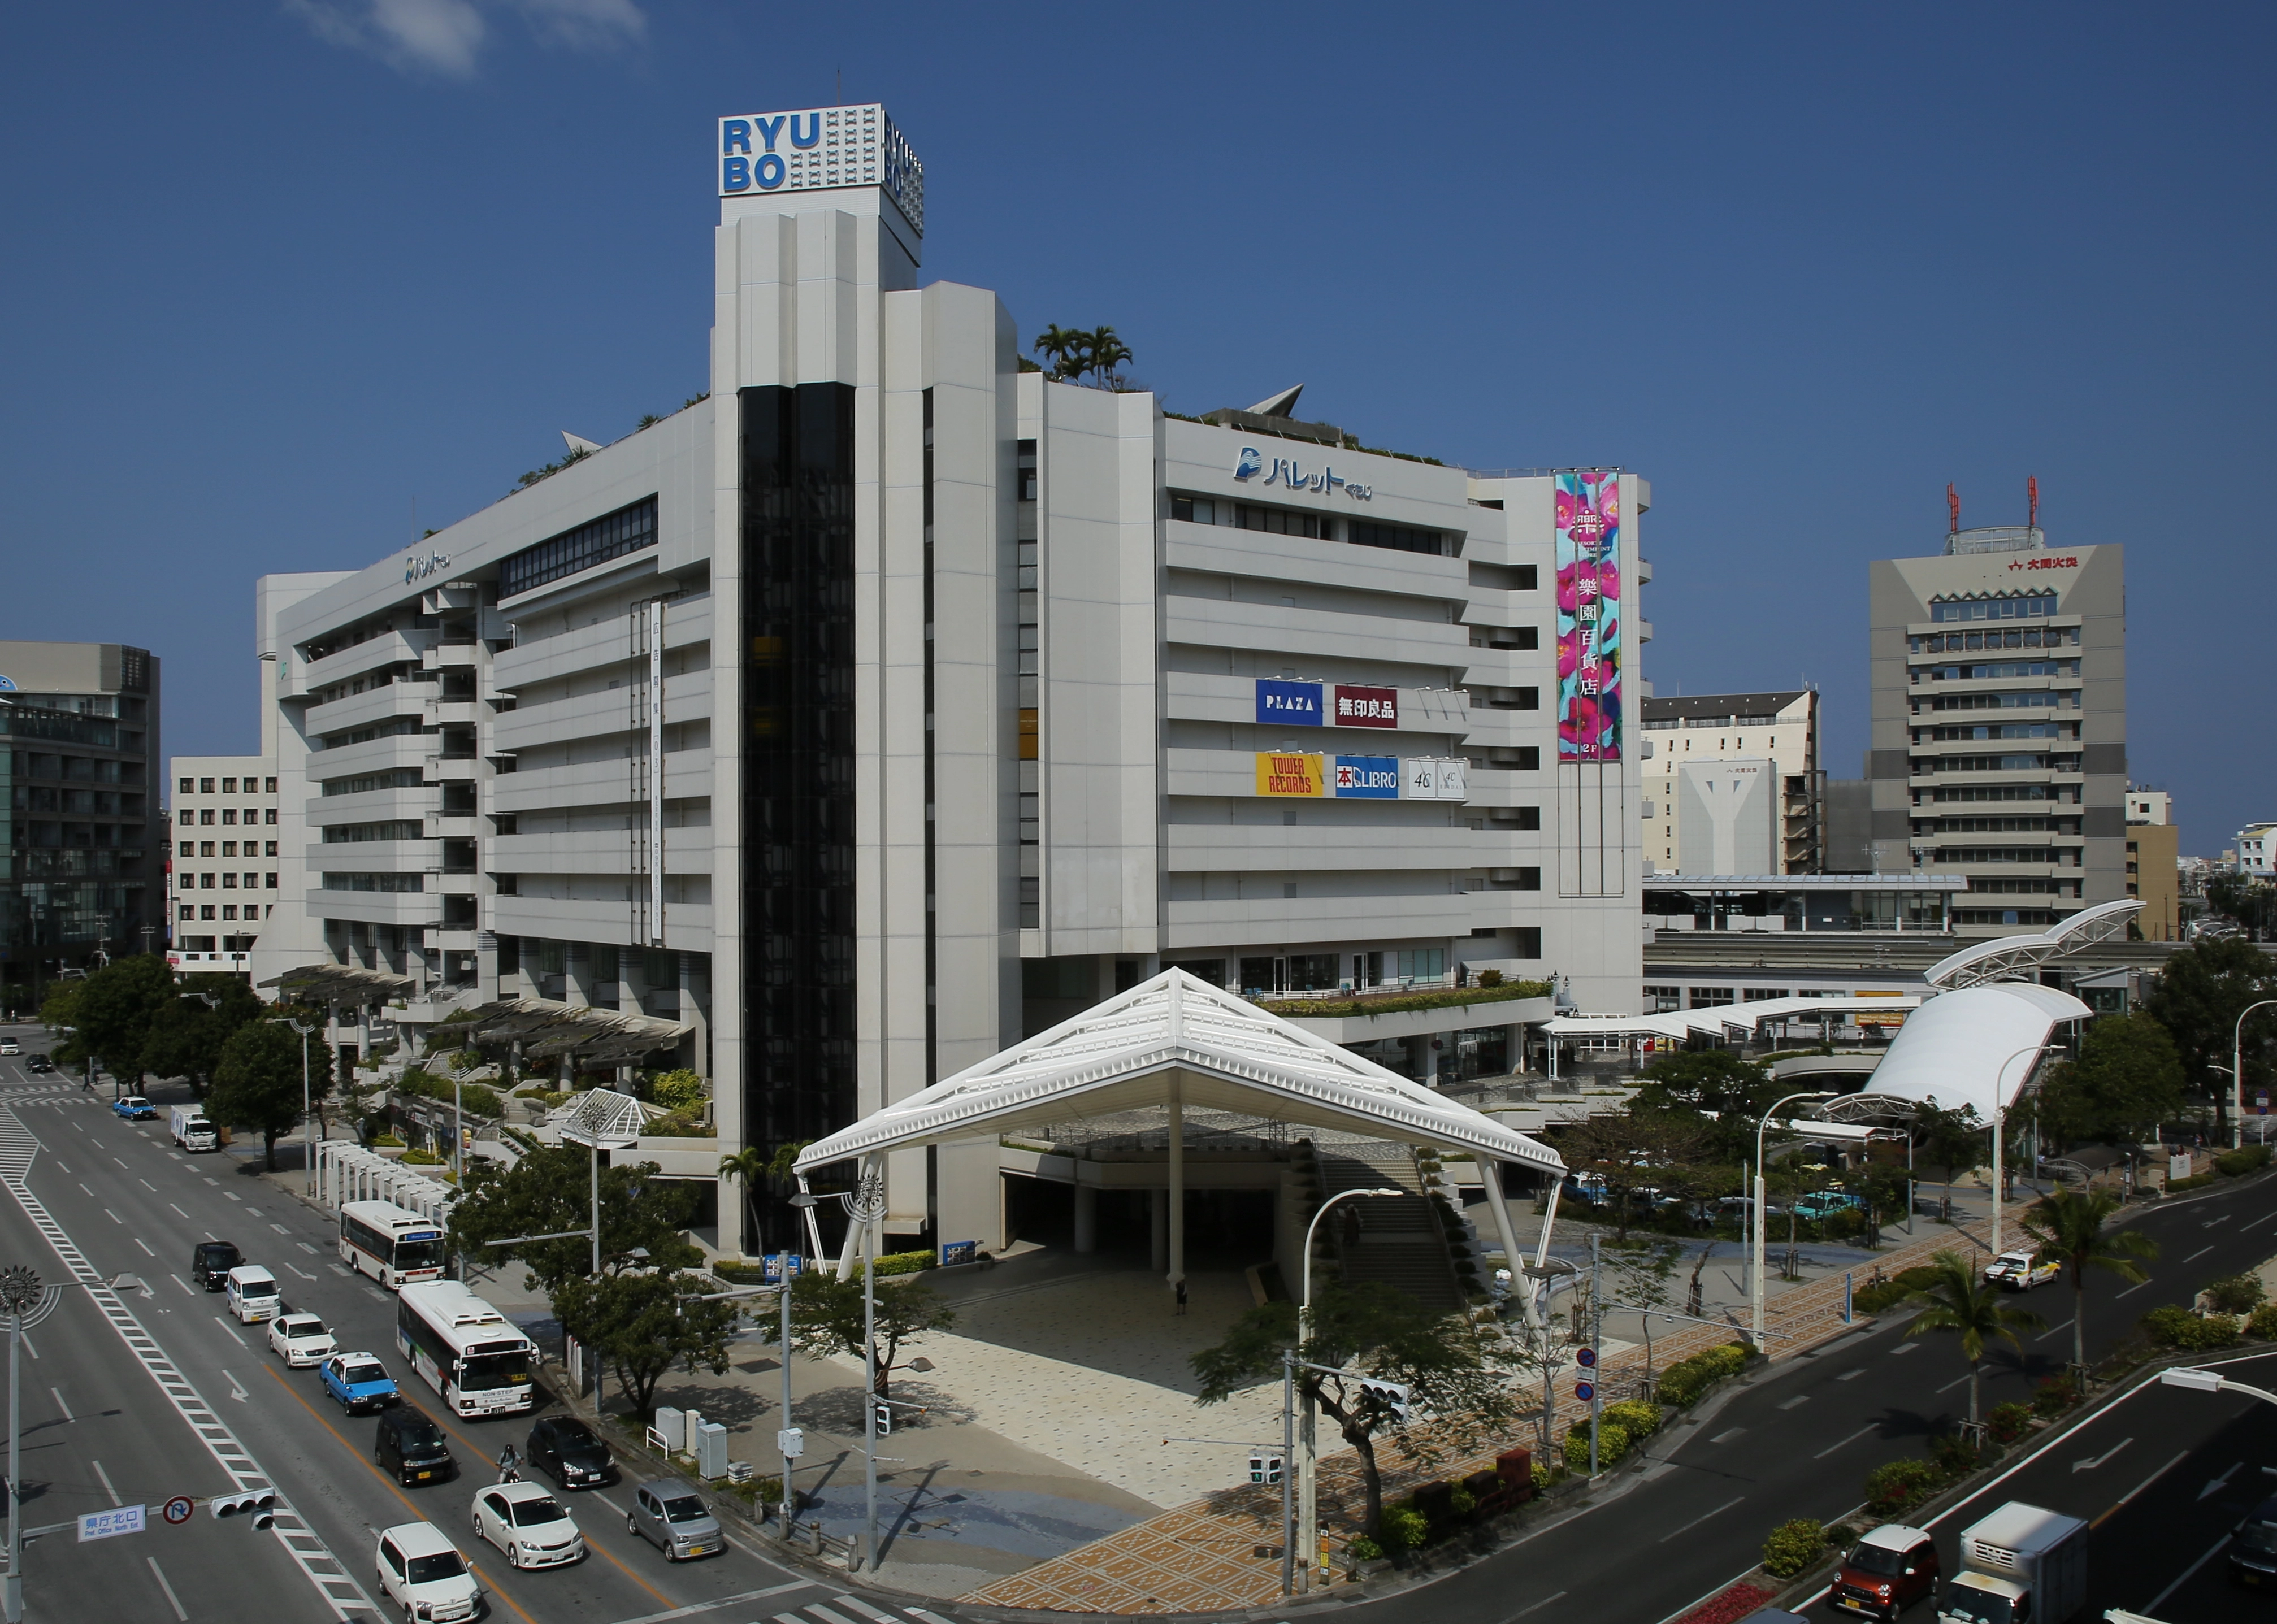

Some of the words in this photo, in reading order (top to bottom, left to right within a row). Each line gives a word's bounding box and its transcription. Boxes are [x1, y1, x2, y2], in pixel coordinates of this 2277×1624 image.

[723, 112, 821, 155] RYU
[723, 153, 786, 193] BO
[2027, 556, 2079, 571] 大同火災
[1578, 579, 1599, 696] 樂園百貨店
[1266, 695, 1314, 711] PLAZA
[1338, 696, 1394, 719] 無印良品
[1583, 744, 1598, 753] 2F
[1272, 757, 1305, 775] TOWER
[1268, 776, 1312, 793] RECORDS
[1338, 767, 1351, 786] 本
[1361, 771, 1397, 788] LIBRO
[86, 1511, 137, 1529] 県庁北口
